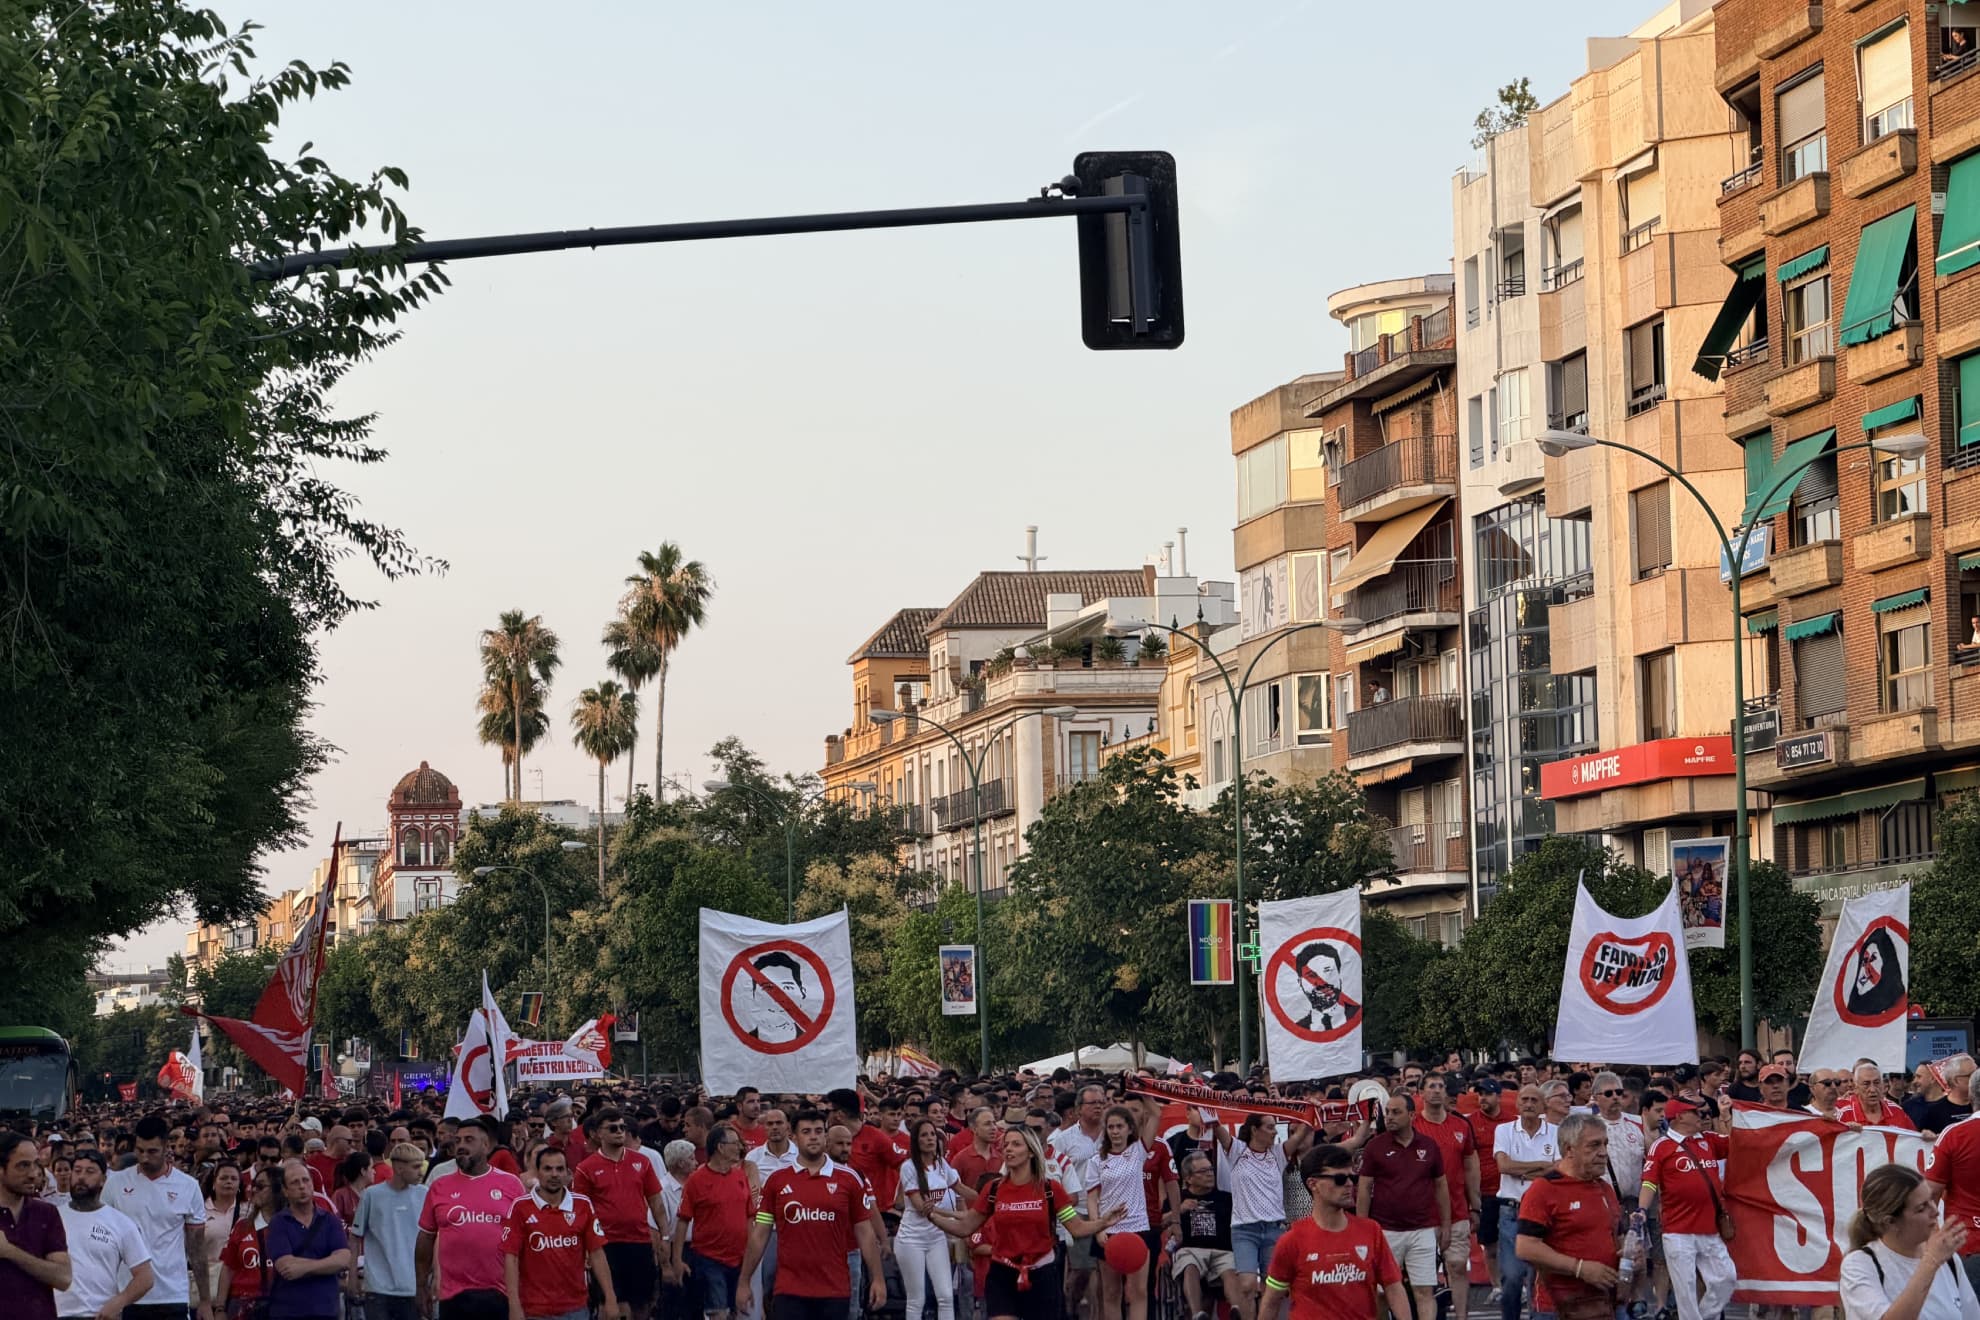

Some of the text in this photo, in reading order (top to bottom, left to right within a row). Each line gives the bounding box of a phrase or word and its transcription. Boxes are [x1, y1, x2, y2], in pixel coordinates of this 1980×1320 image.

[1684, 756, 1716, 764] MAPFRE
[1791, 745, 1802, 758] 854
[1803, 744, 1809, 755] 71
[1809, 741, 1816, 754] 12
[1581, 755, 1621, 783] MAPFRE
[1601, 945, 1667, 969] FAMILIA
[1591, 961, 1665, 988] DEL NIDO
[447, 1205, 501, 1226] Midea
[784, 1201, 836, 1224] Midea
[529, 1231, 578, 1252] Midea
[1312, 1268, 1366, 1285] Malaysia
[1335, 1263, 1356, 1273] Visit
